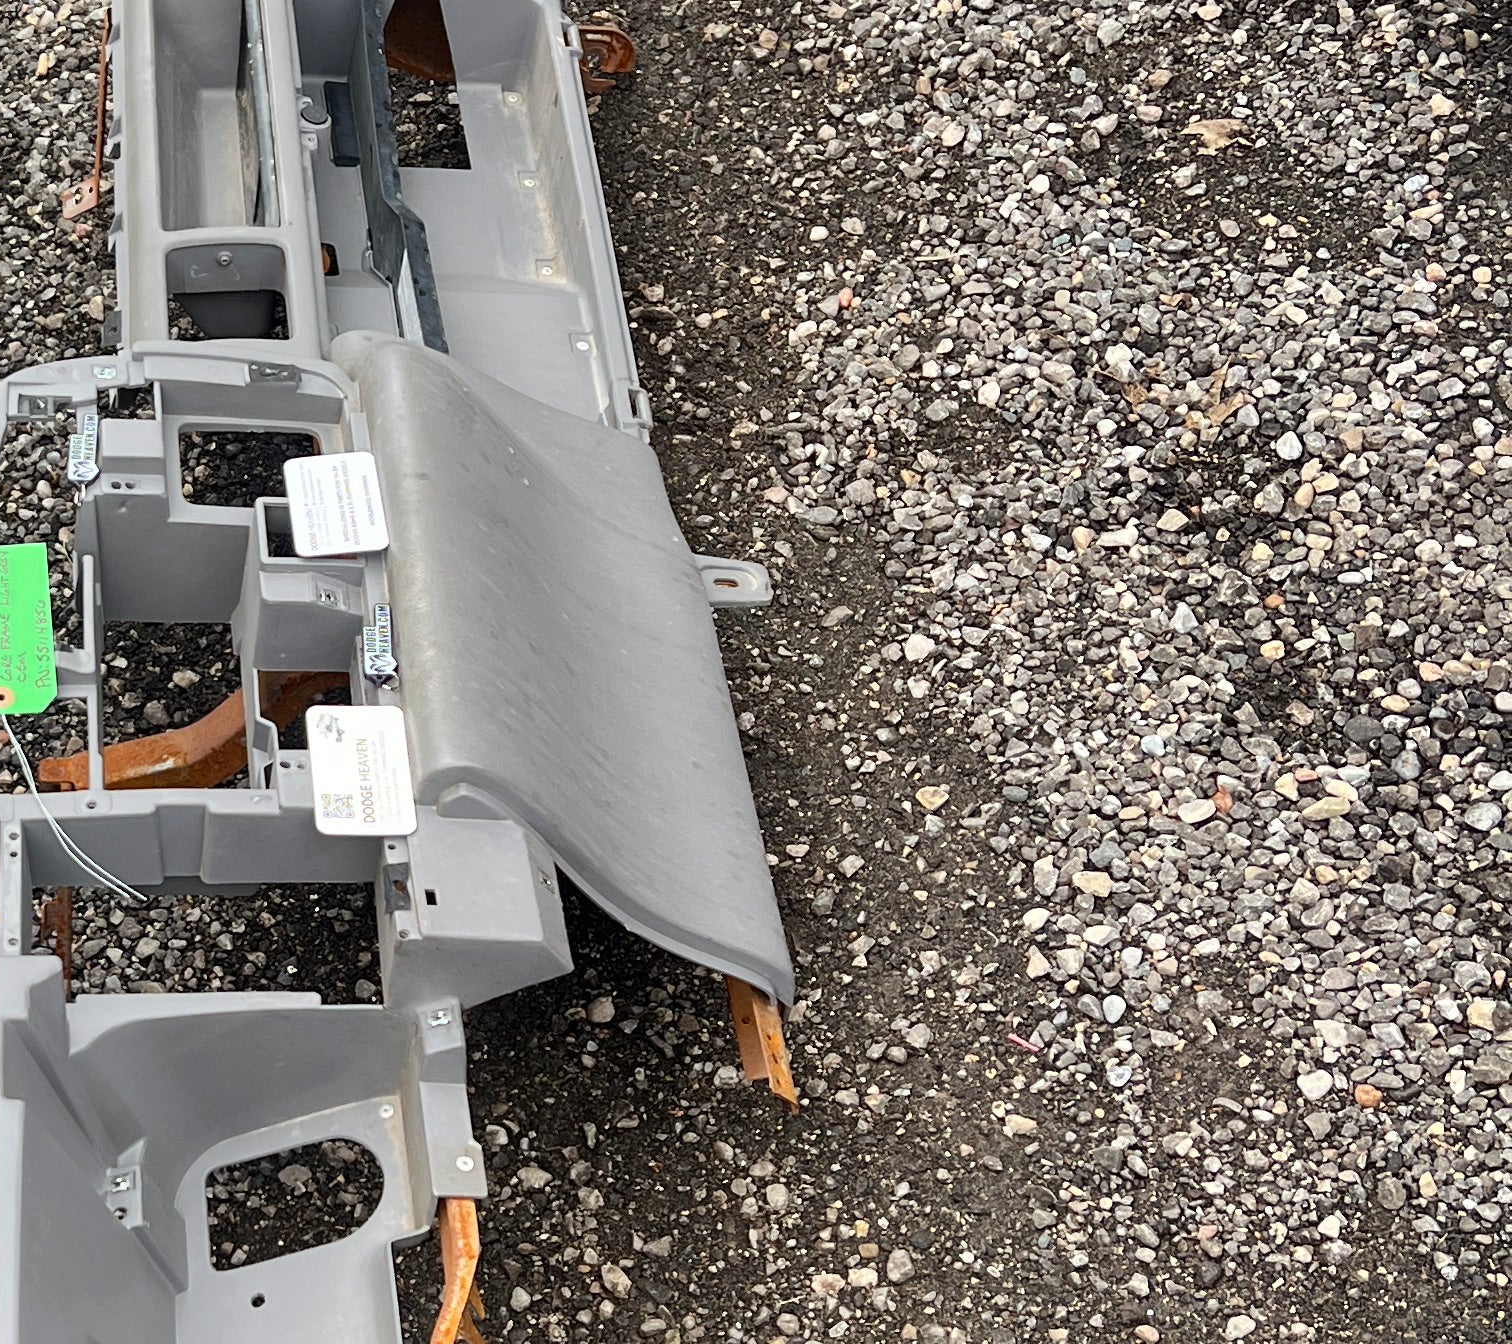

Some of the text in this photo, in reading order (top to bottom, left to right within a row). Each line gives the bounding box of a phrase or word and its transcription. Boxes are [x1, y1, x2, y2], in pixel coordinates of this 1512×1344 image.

[71, 436, 83, 460] DODGE
[83, 415, 97, 461] HEAVEN.COM
[365, 627, 377, 653] DODGE
[377, 605, 390, 654] HEAVEN.COM
[16, 650, 28, 683] OEM
[355, 738, 376, 823] DODGE HEAVEN
